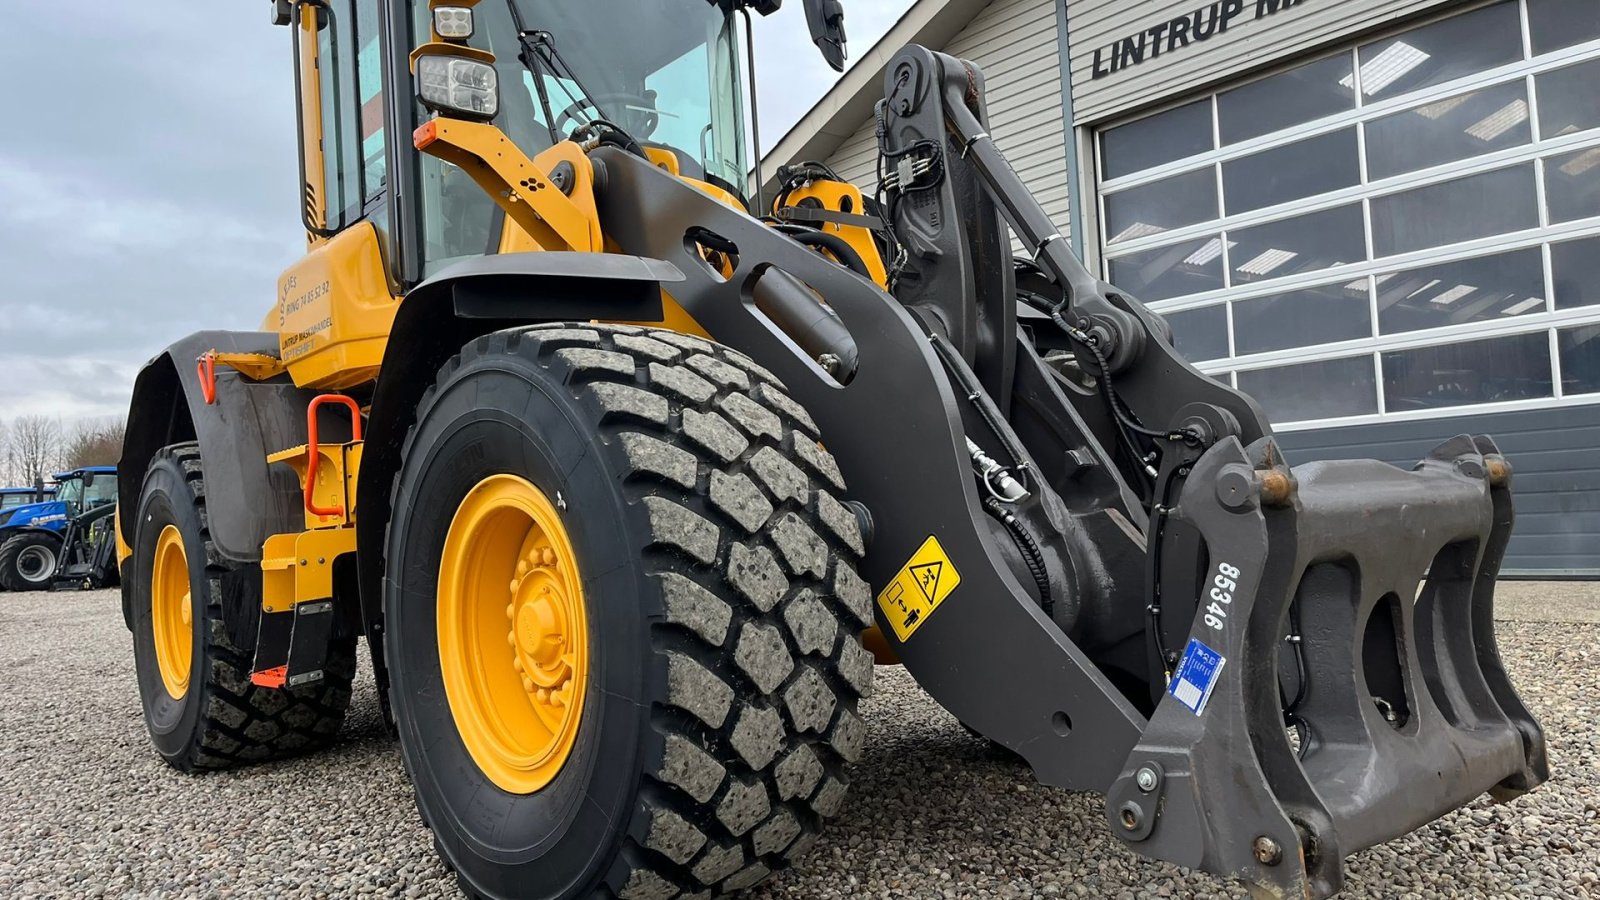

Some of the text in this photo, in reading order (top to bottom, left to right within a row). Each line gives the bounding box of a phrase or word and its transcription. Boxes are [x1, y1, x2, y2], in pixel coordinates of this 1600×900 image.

[1092, 0, 1243, 80] LINTRUP
[286, 298, 300, 316] RING
[308, 289, 314, 304] 85
[322, 280, 330, 295] 92
[282, 334, 298, 350] LINTRUP
[1204, 562, 1241, 631] 85346
[1175, 656, 1188, 679] VOLVO
